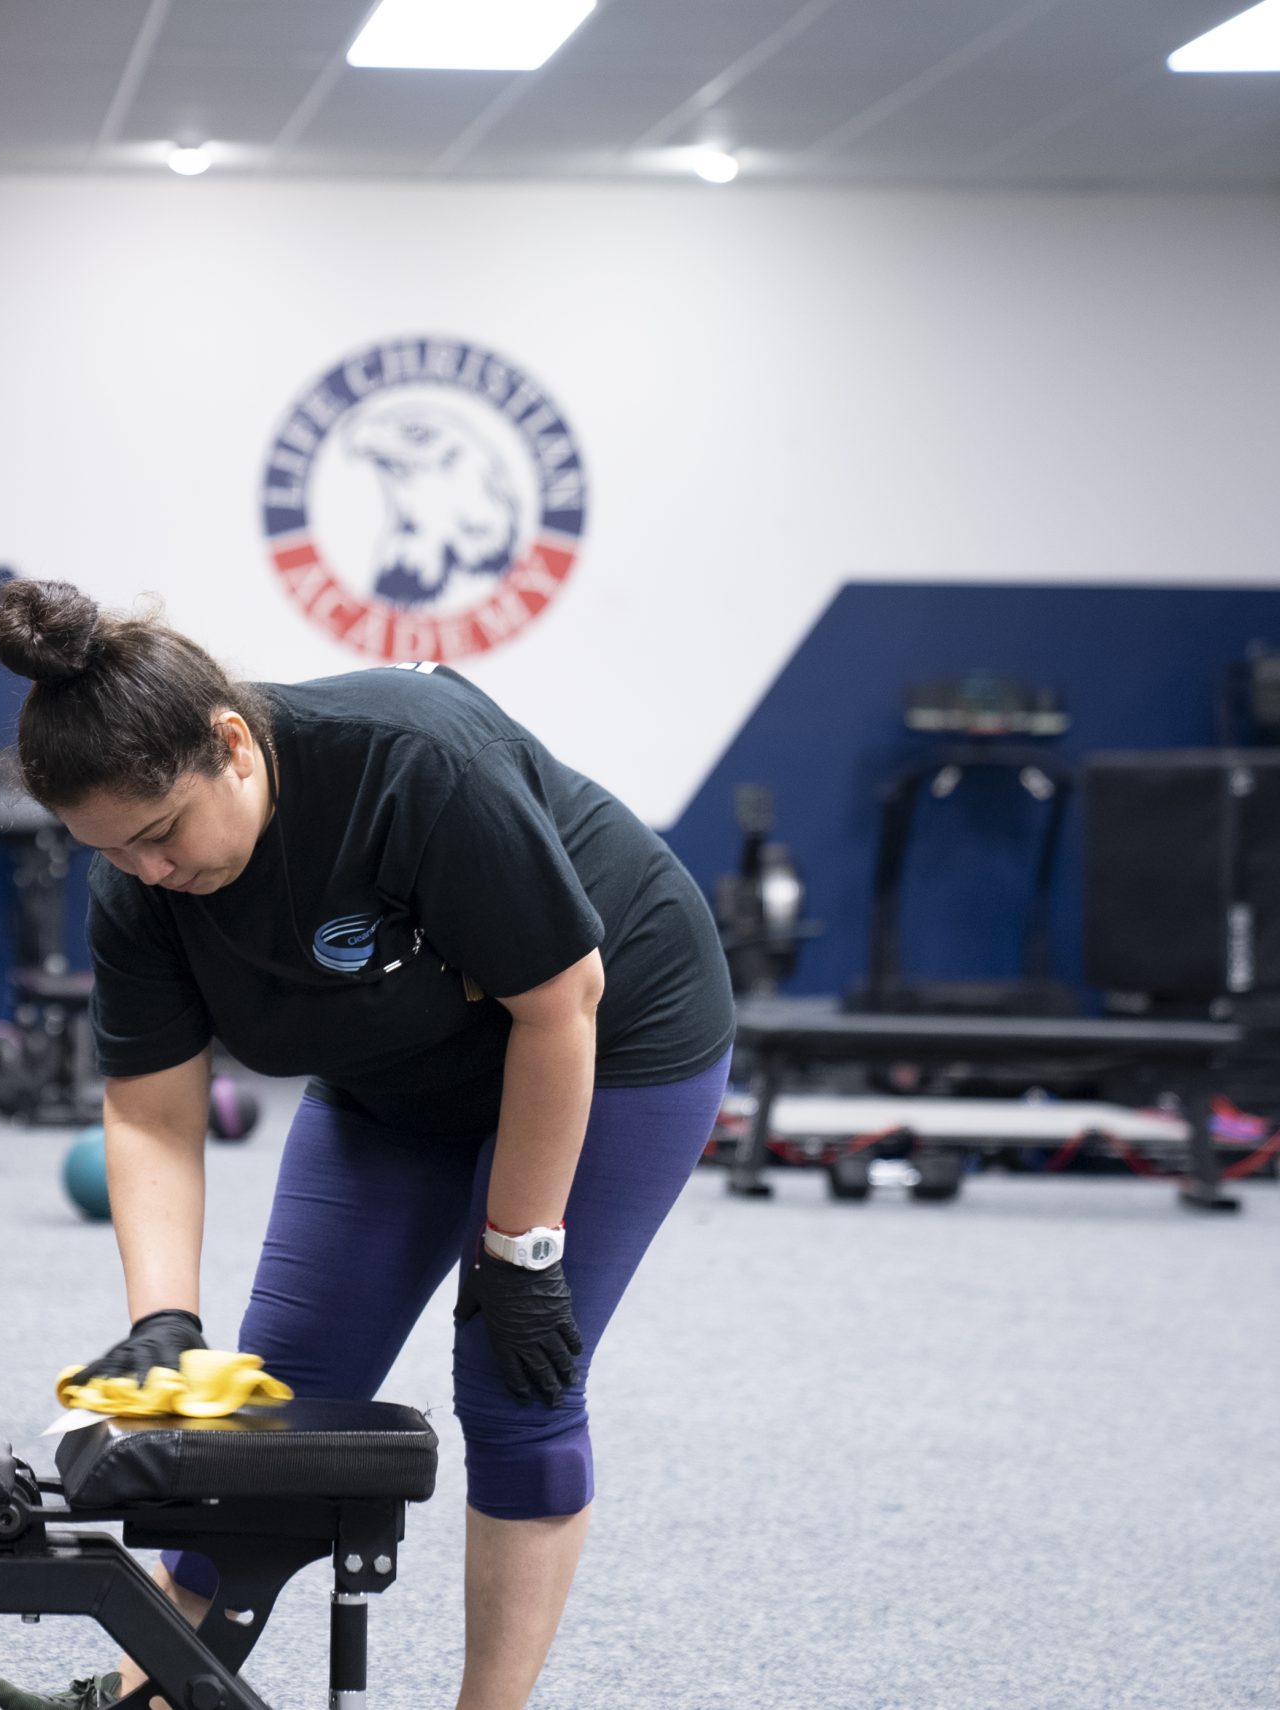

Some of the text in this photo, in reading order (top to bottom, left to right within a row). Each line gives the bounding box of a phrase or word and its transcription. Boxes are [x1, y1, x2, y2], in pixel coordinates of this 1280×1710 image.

[264, 340, 582, 510] LIFE CHRISTIAN
[280, 552, 560, 660] ACADEMY
